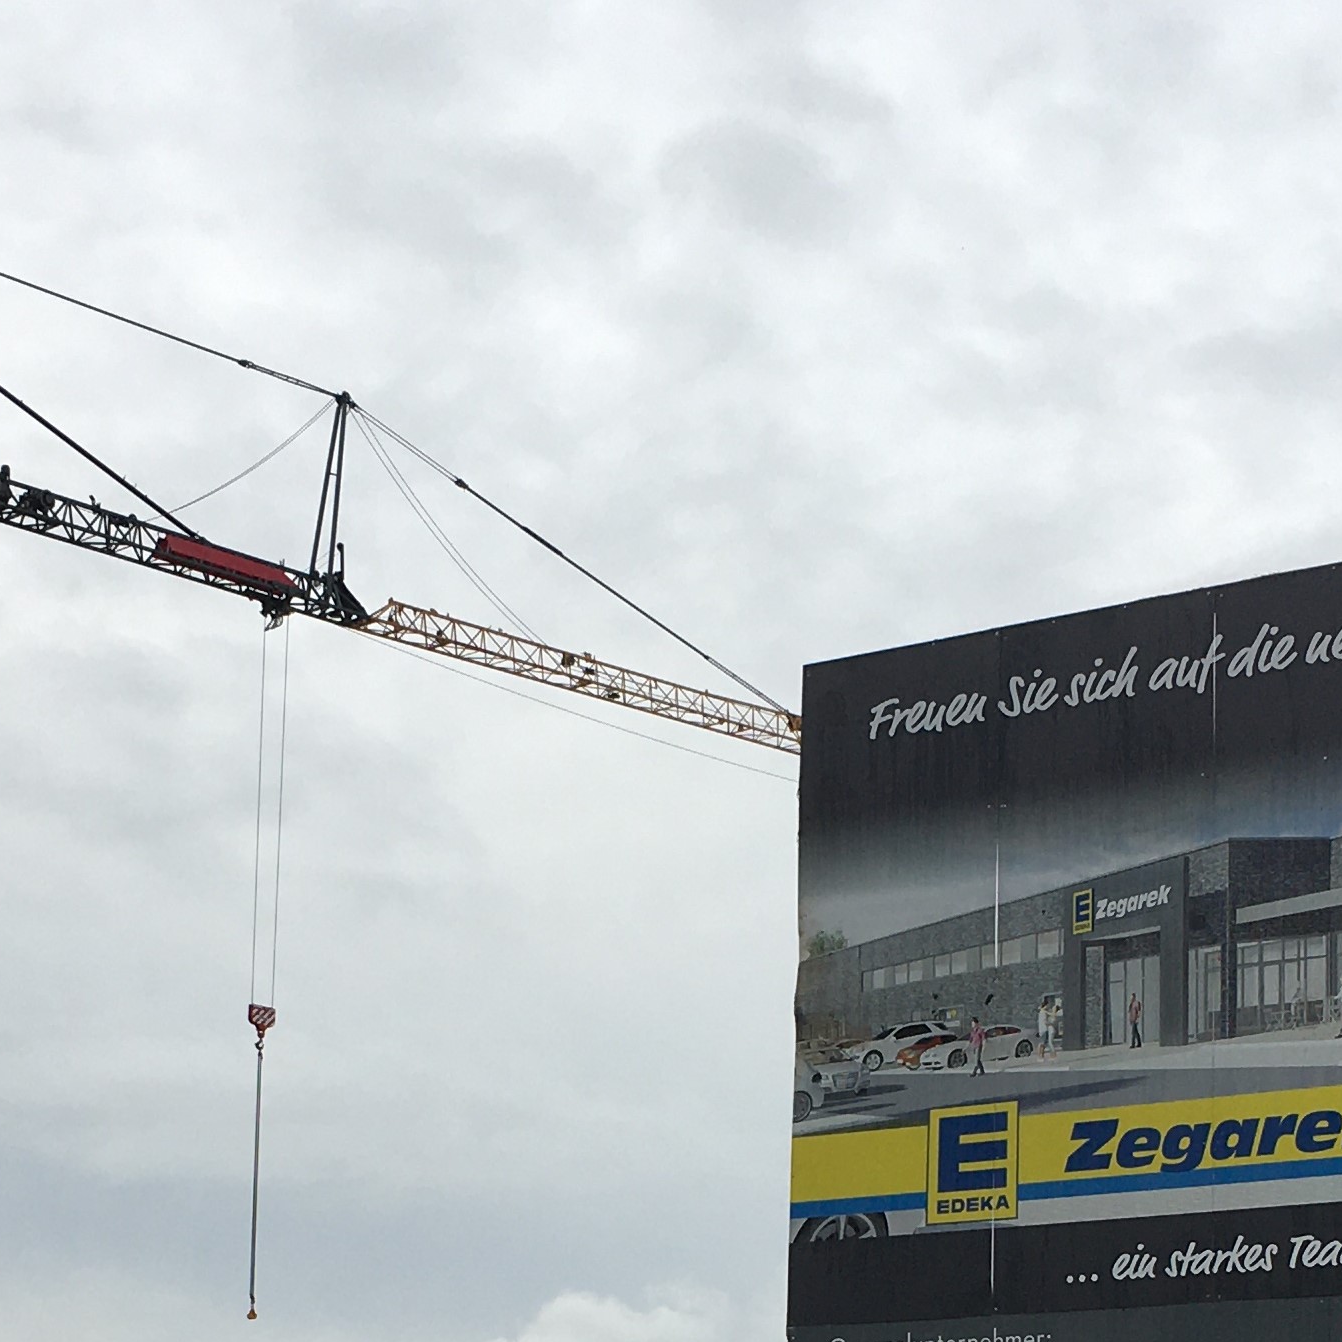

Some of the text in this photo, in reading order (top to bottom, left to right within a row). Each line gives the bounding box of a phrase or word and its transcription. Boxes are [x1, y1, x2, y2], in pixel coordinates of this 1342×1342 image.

[869, 690, 985, 739] Freuen
[998, 669, 1058, 717] Sie
[1063, 646, 1137, 707] sich
[1148, 635, 1223, 693] auf
[1226, 623, 1298, 679] die
[1096, 885, 1171, 920] Zegarek
[936, 1194, 1011, 1215] EDEKA
[1112, 1244, 1157, 1281] ein
[1164, 1236, 1277, 1277] starkes
